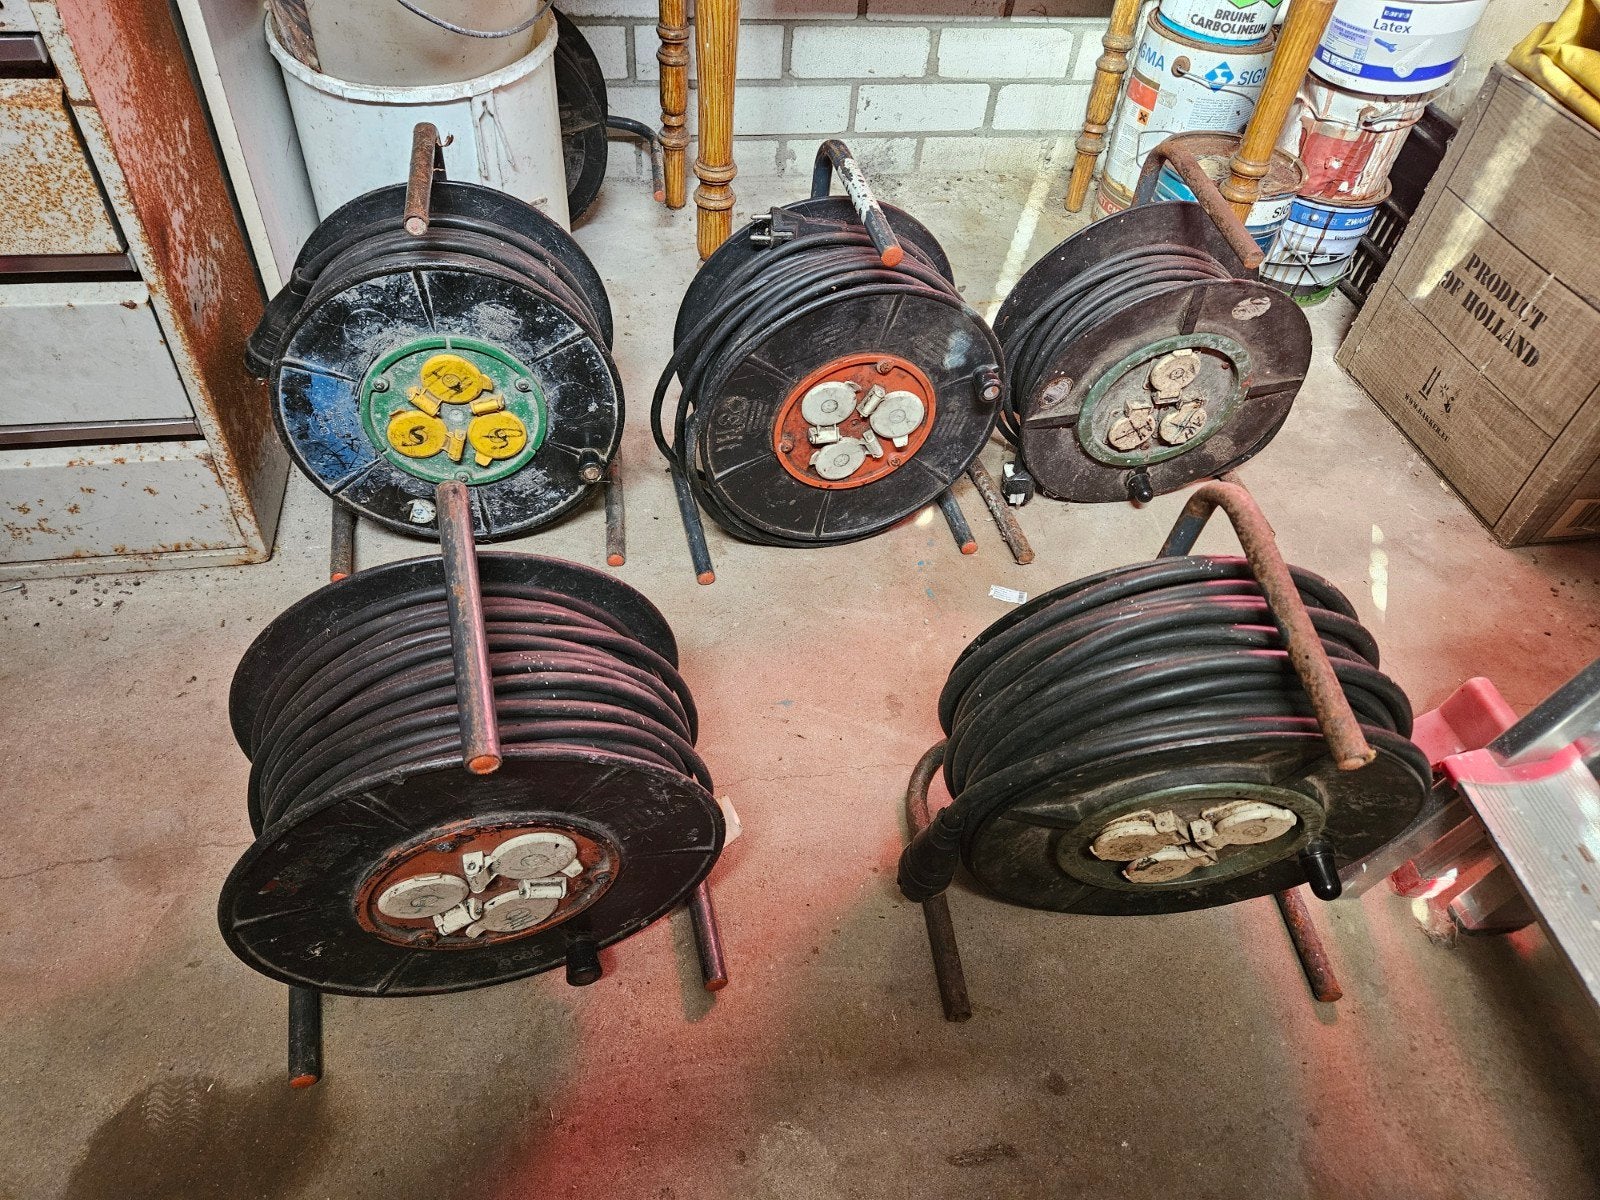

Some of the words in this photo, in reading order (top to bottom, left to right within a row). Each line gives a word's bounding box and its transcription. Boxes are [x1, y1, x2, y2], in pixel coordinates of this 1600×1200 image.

[1190, 13, 1268, 35] CARBOLINEUM
[1214, 8, 1258, 24] BRUINE
[1373, 18, 1413, 34] Latex
[1464, 252, 1549, 331] PRODUCT
[1440, 270, 1466, 297] OF
[1461, 289, 1540, 368] HOLLAND
